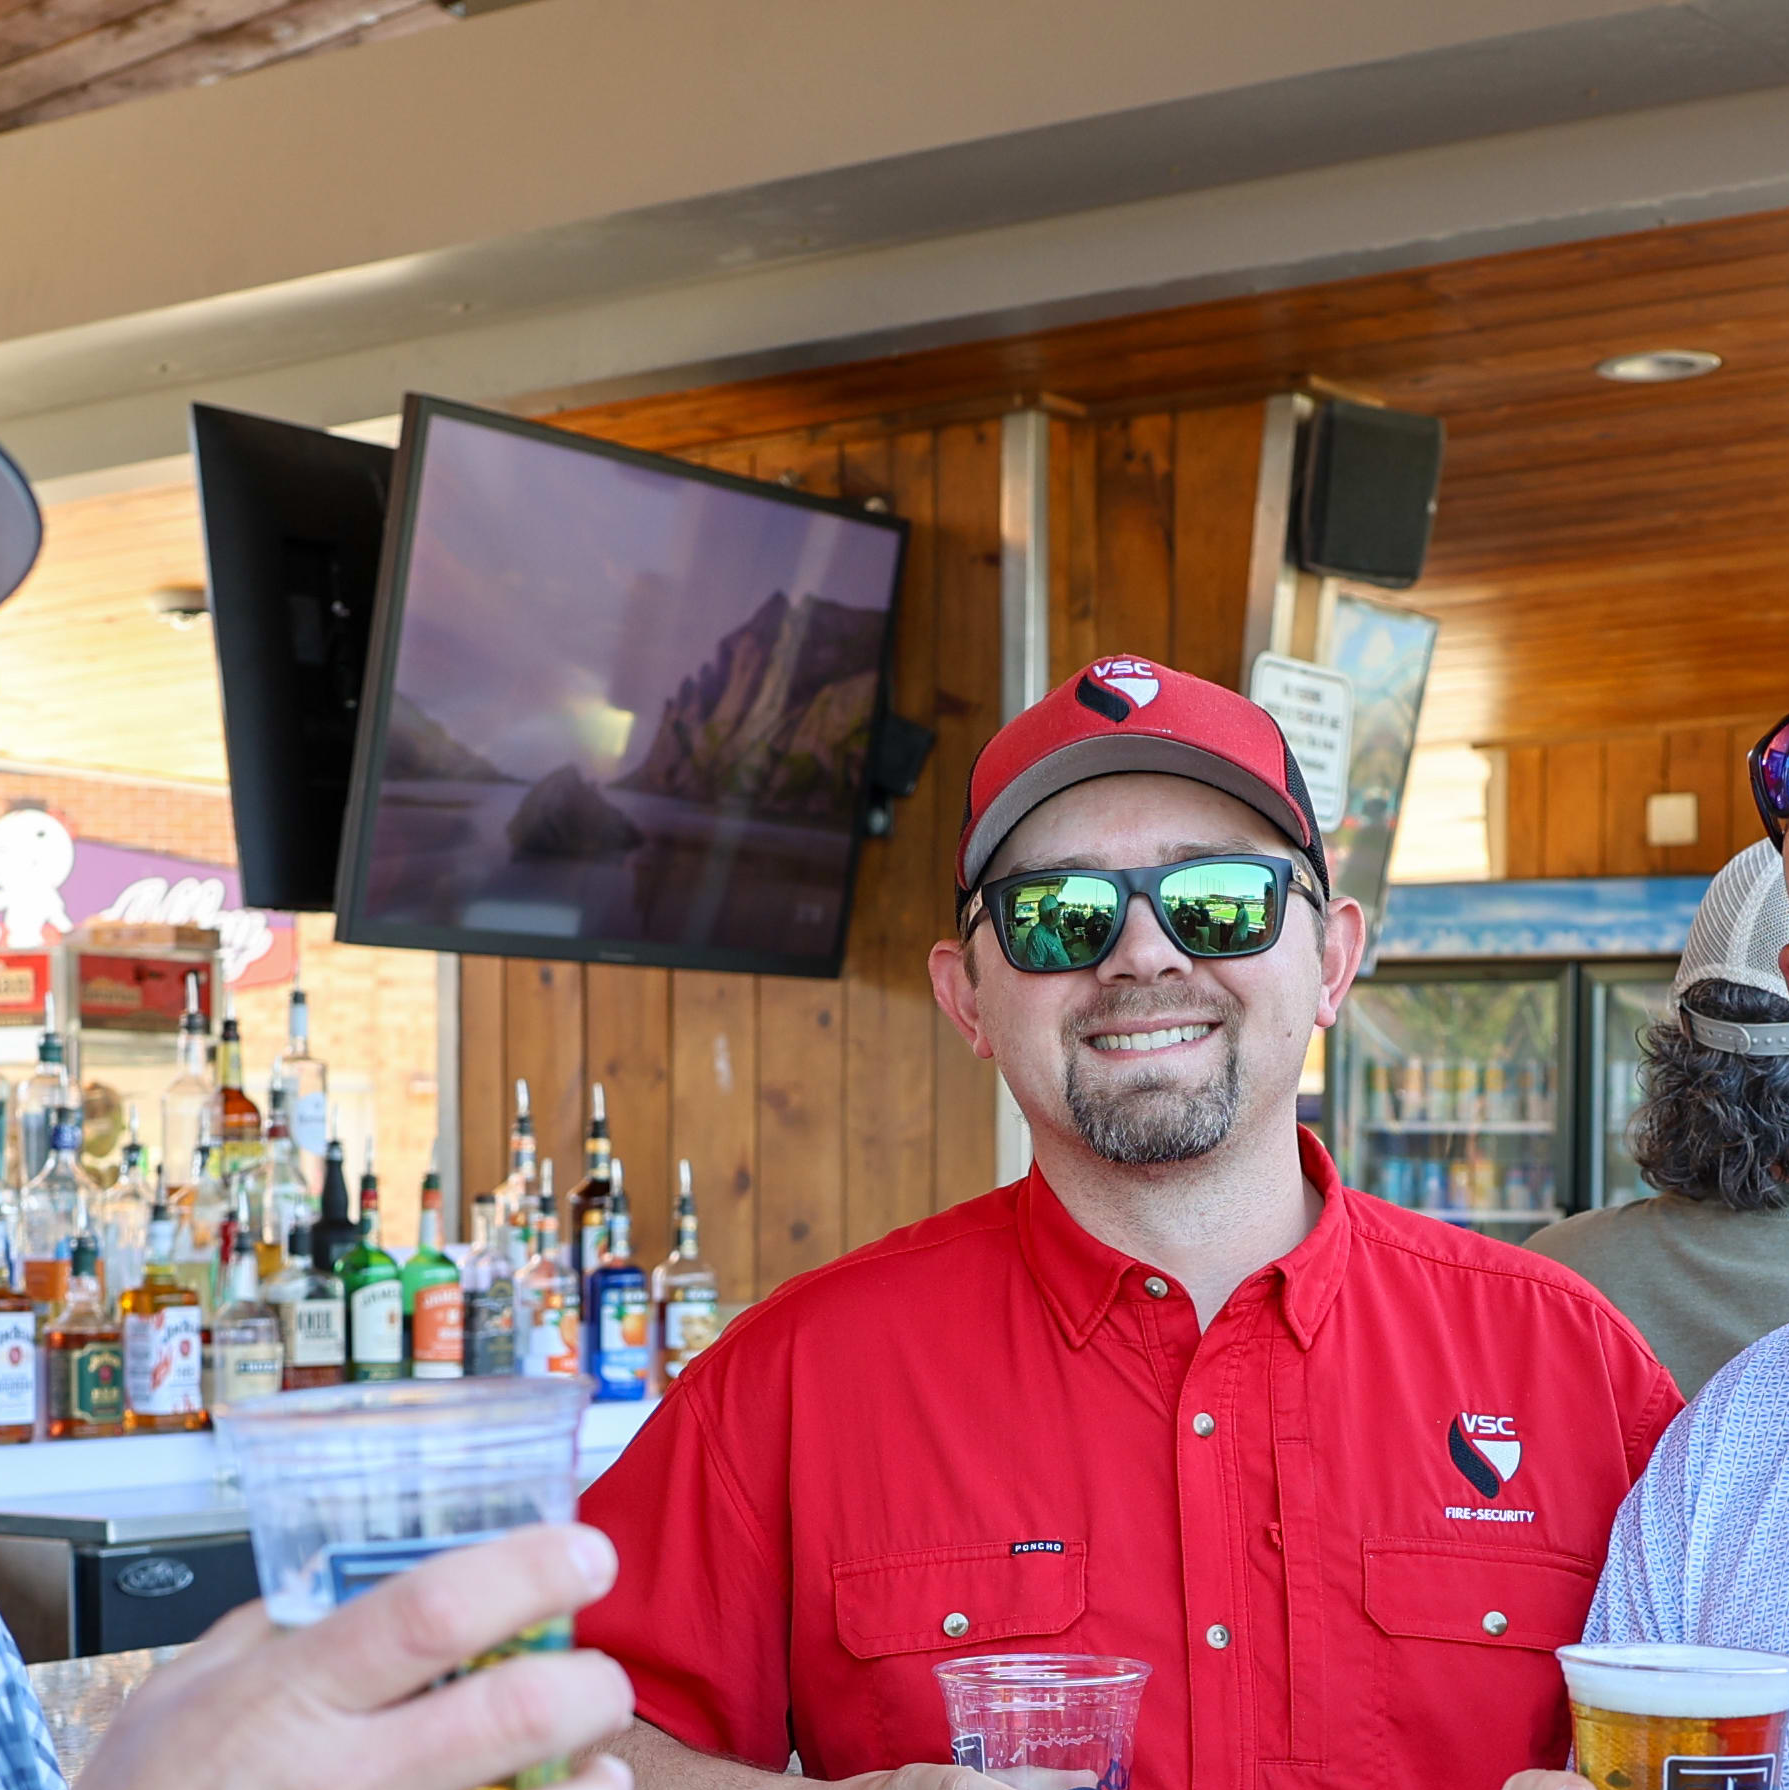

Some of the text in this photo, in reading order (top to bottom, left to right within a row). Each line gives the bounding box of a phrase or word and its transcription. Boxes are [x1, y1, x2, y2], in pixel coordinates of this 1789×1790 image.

[1093, 660, 1153, 678] VSC
[1461, 1412, 1516, 1436] VSC
[1015, 1542, 1062, 1553] PONCHO
